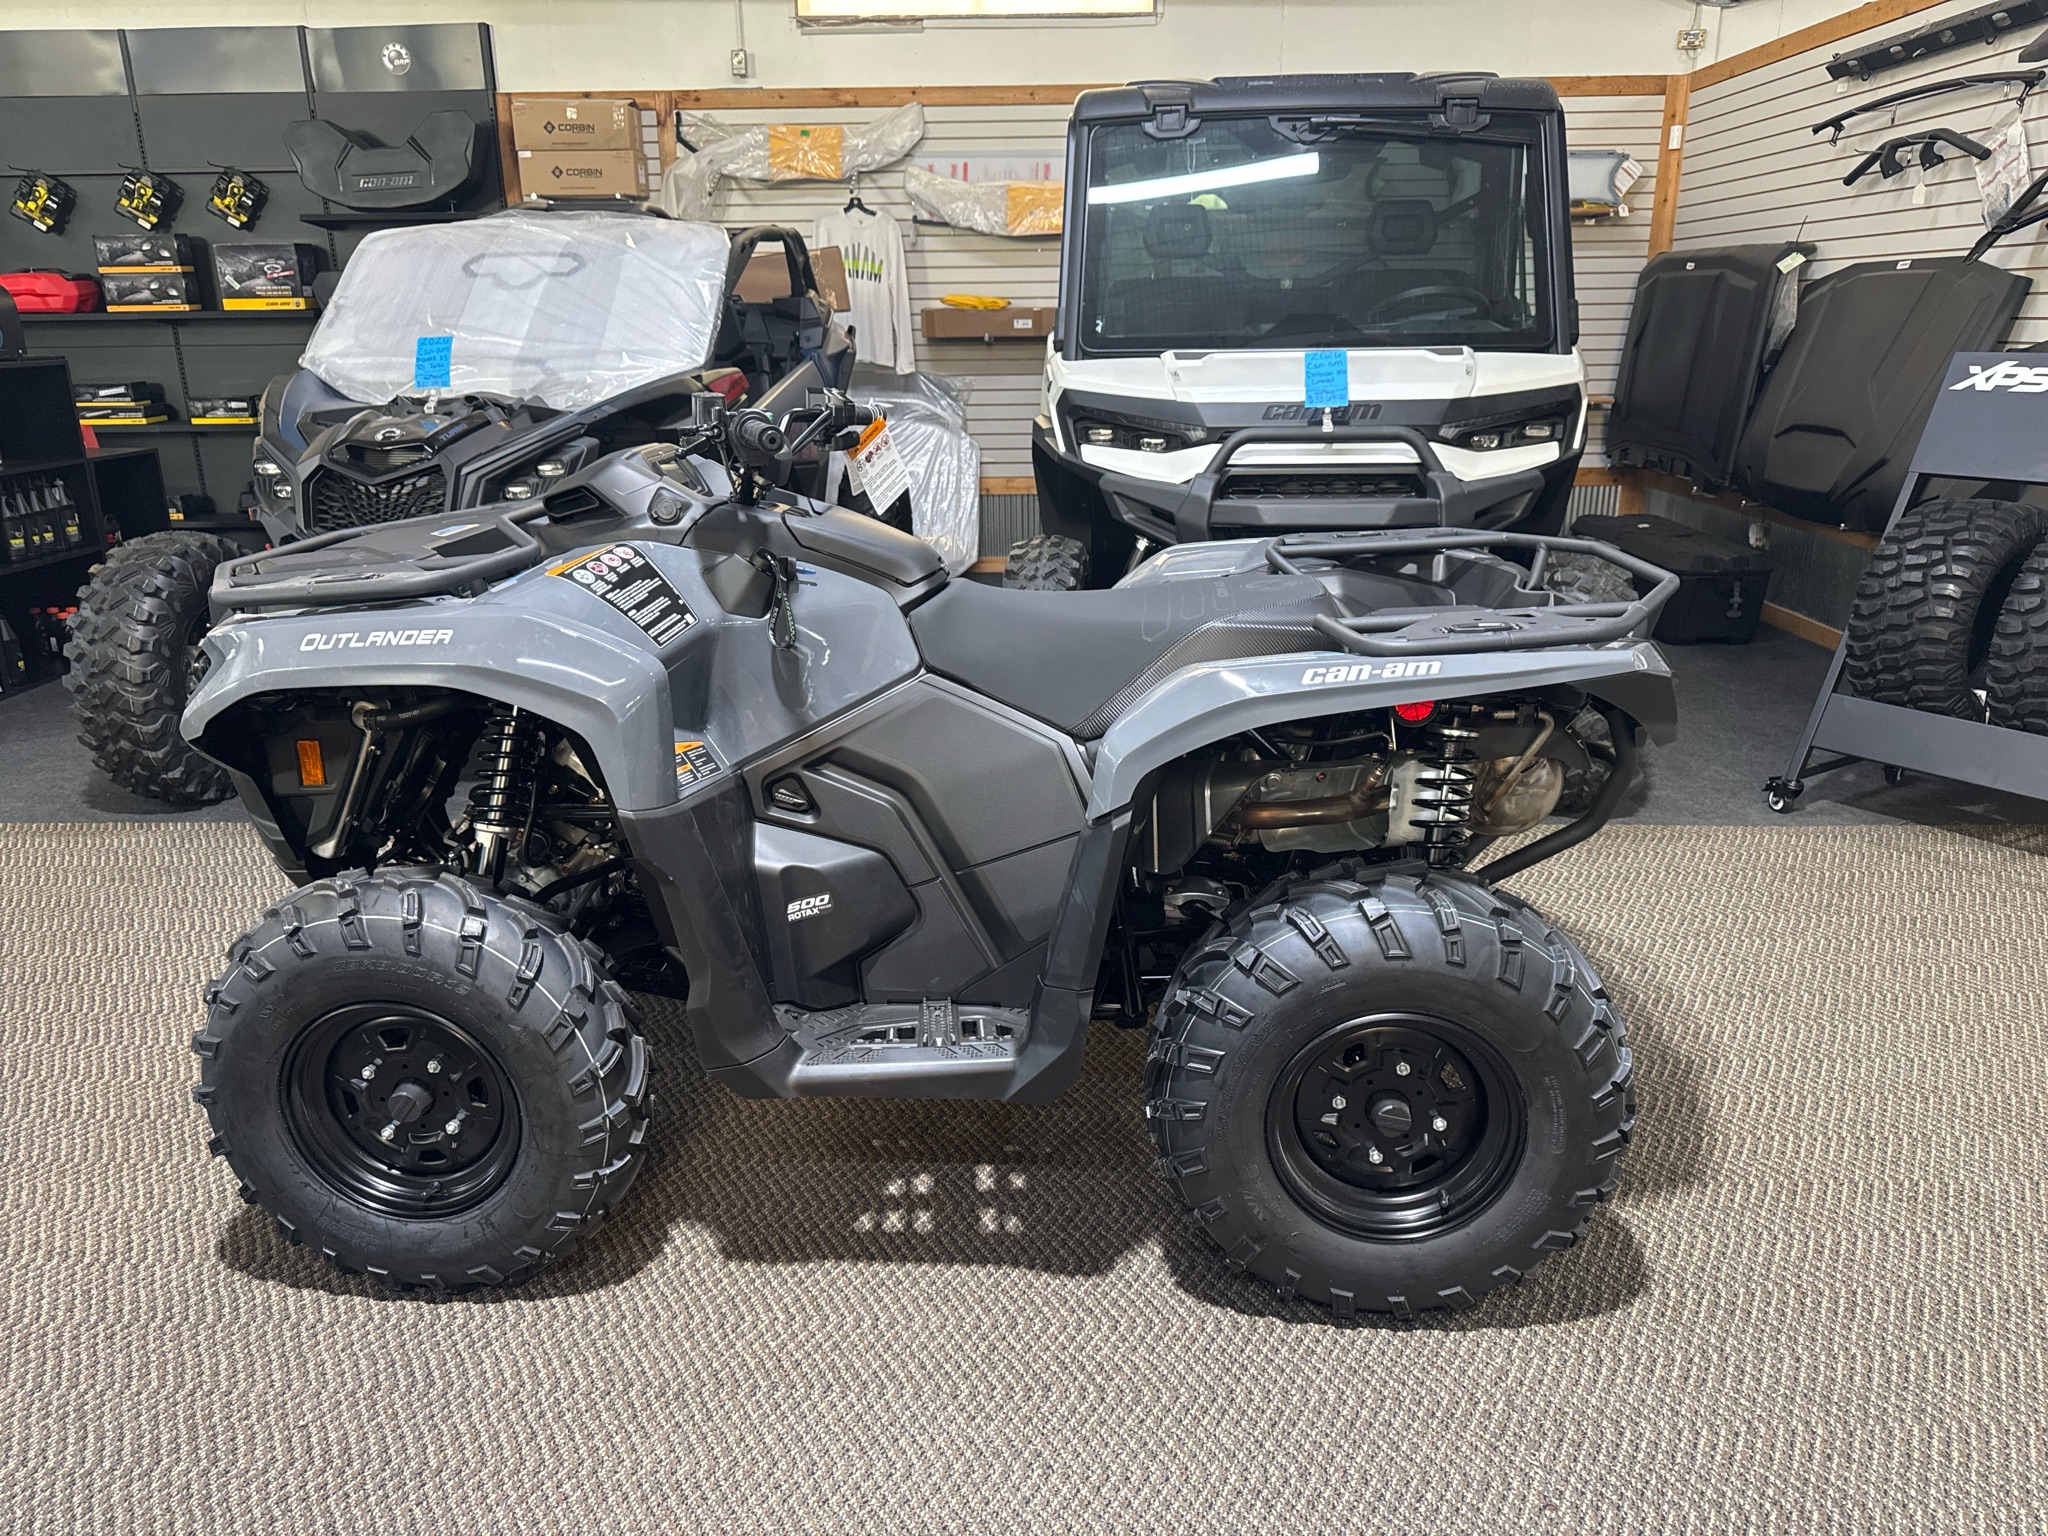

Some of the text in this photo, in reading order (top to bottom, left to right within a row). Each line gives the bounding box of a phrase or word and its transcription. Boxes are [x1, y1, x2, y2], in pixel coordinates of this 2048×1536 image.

[557, 123, 596, 133] CORBIN
[359, 175, 415, 188] can-am
[565, 168, 603, 177] CORBIN
[420, 337, 449, 346] 2026
[1948, 360, 2048, 393] XPS
[440, 422, 468, 441] TURBO
[859, 425, 881, 447] WARNING
[300, 629, 454, 651] OUTLANDER
[1301, 661, 1442, 685] can-am
[787, 894, 830, 914] 500
[788, 906, 820, 922] ROTAX
